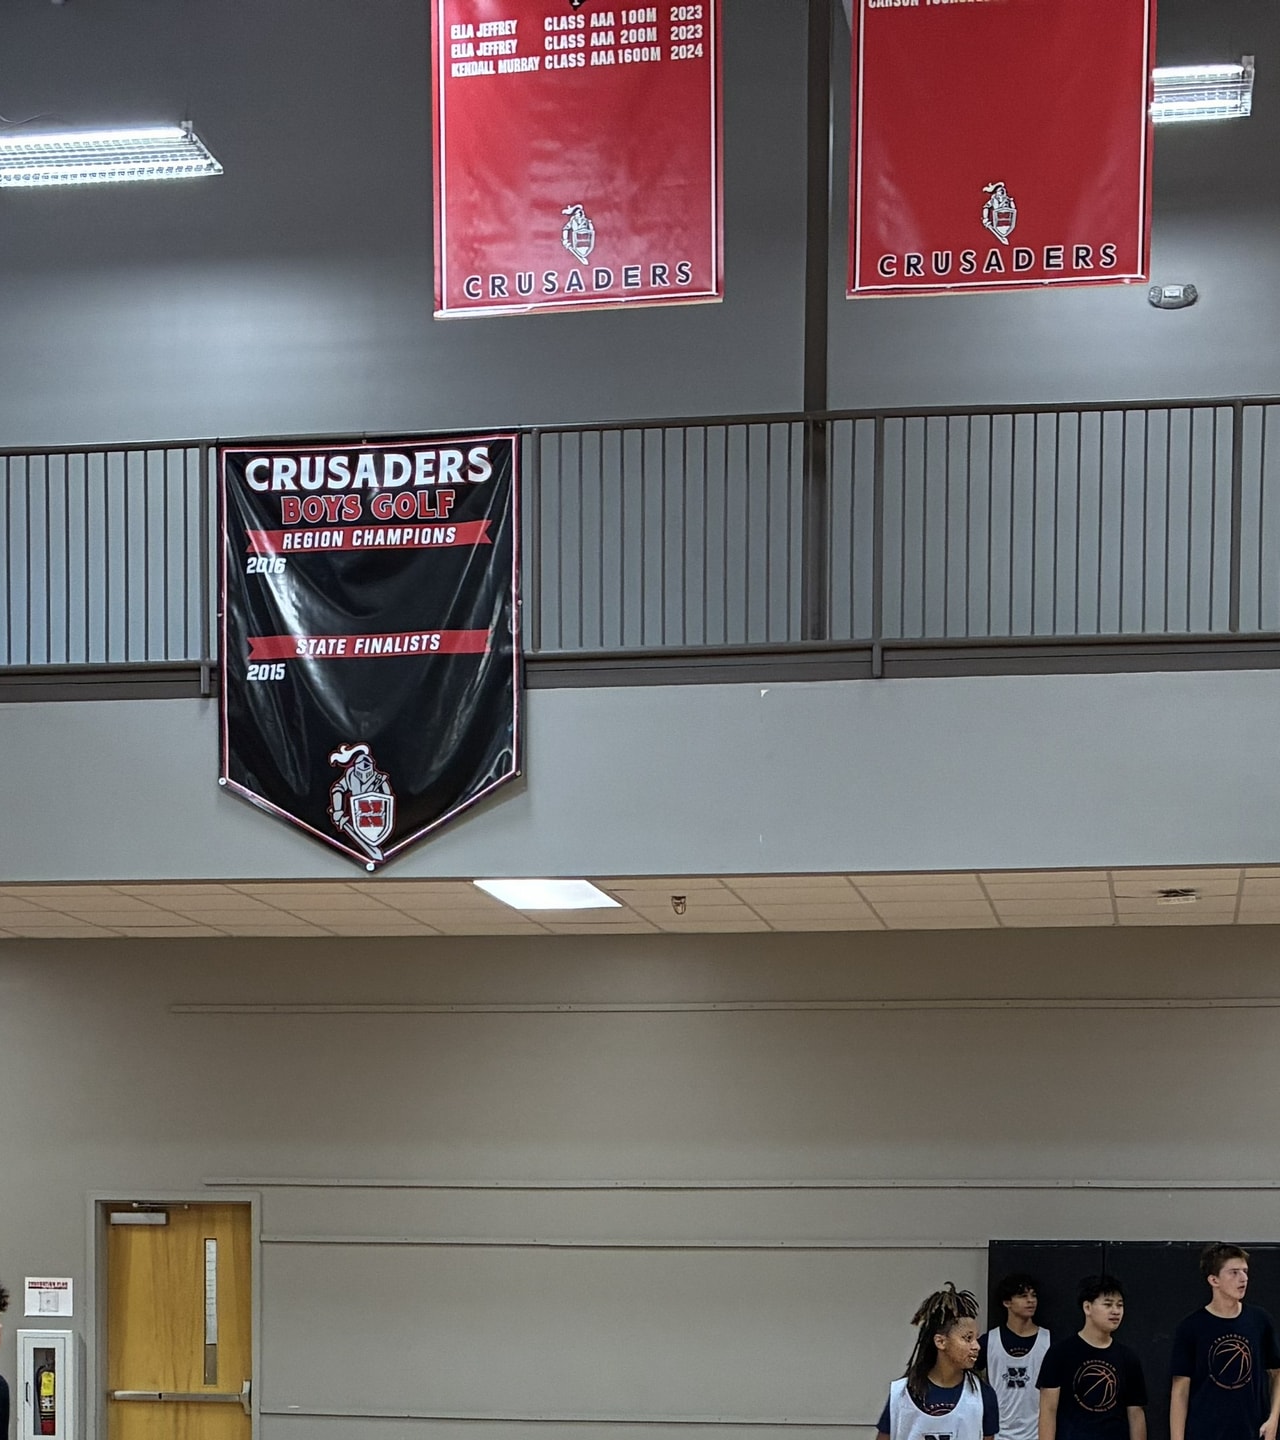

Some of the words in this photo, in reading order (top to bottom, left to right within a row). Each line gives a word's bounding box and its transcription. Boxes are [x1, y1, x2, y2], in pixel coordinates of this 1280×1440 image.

[451, 23, 475, 40] ELLA
[476, 20, 518, 38] JEFFREY
[544, 14, 585, 32] CLASS
[590, 11, 615, 29] AAA
[621, 7, 657, 26] 100M
[670, 4, 703, 22] 2023
[451, 42, 475, 59] ELLA
[476, 39, 518, 58] JEFFREY
[544, 33, 585, 51] CLASS
[590, 30, 615, 48] AAA
[620, 27, 657, 45] 200M
[670, 24, 703, 42] 2023
[451, 60, 496, 78] KENDALL
[498, 56, 541, 76] MURRAY
[544, 52, 585, 70] CLASS
[590, 49, 616, 67] AAA
[618, 46, 661, 65] 1600M
[670, 43, 704, 61] 2024
[878, 243, 1117, 278] CRUSADERS
[464, 261, 693, 300] CRUSADERS
[245, 446, 493, 491] CRUSADERS
[281, 494, 362, 524] BOYS
[371, 489, 455, 520] GOLF
[282, 530, 343, 549] REGION
[352, 527, 456, 546] CHAMPIONS
[246, 556, 286, 574] 2016
[296, 637, 346, 655] STATE
[354, 634, 441, 654] FINALISTS
[246, 663, 286, 681] 2015
